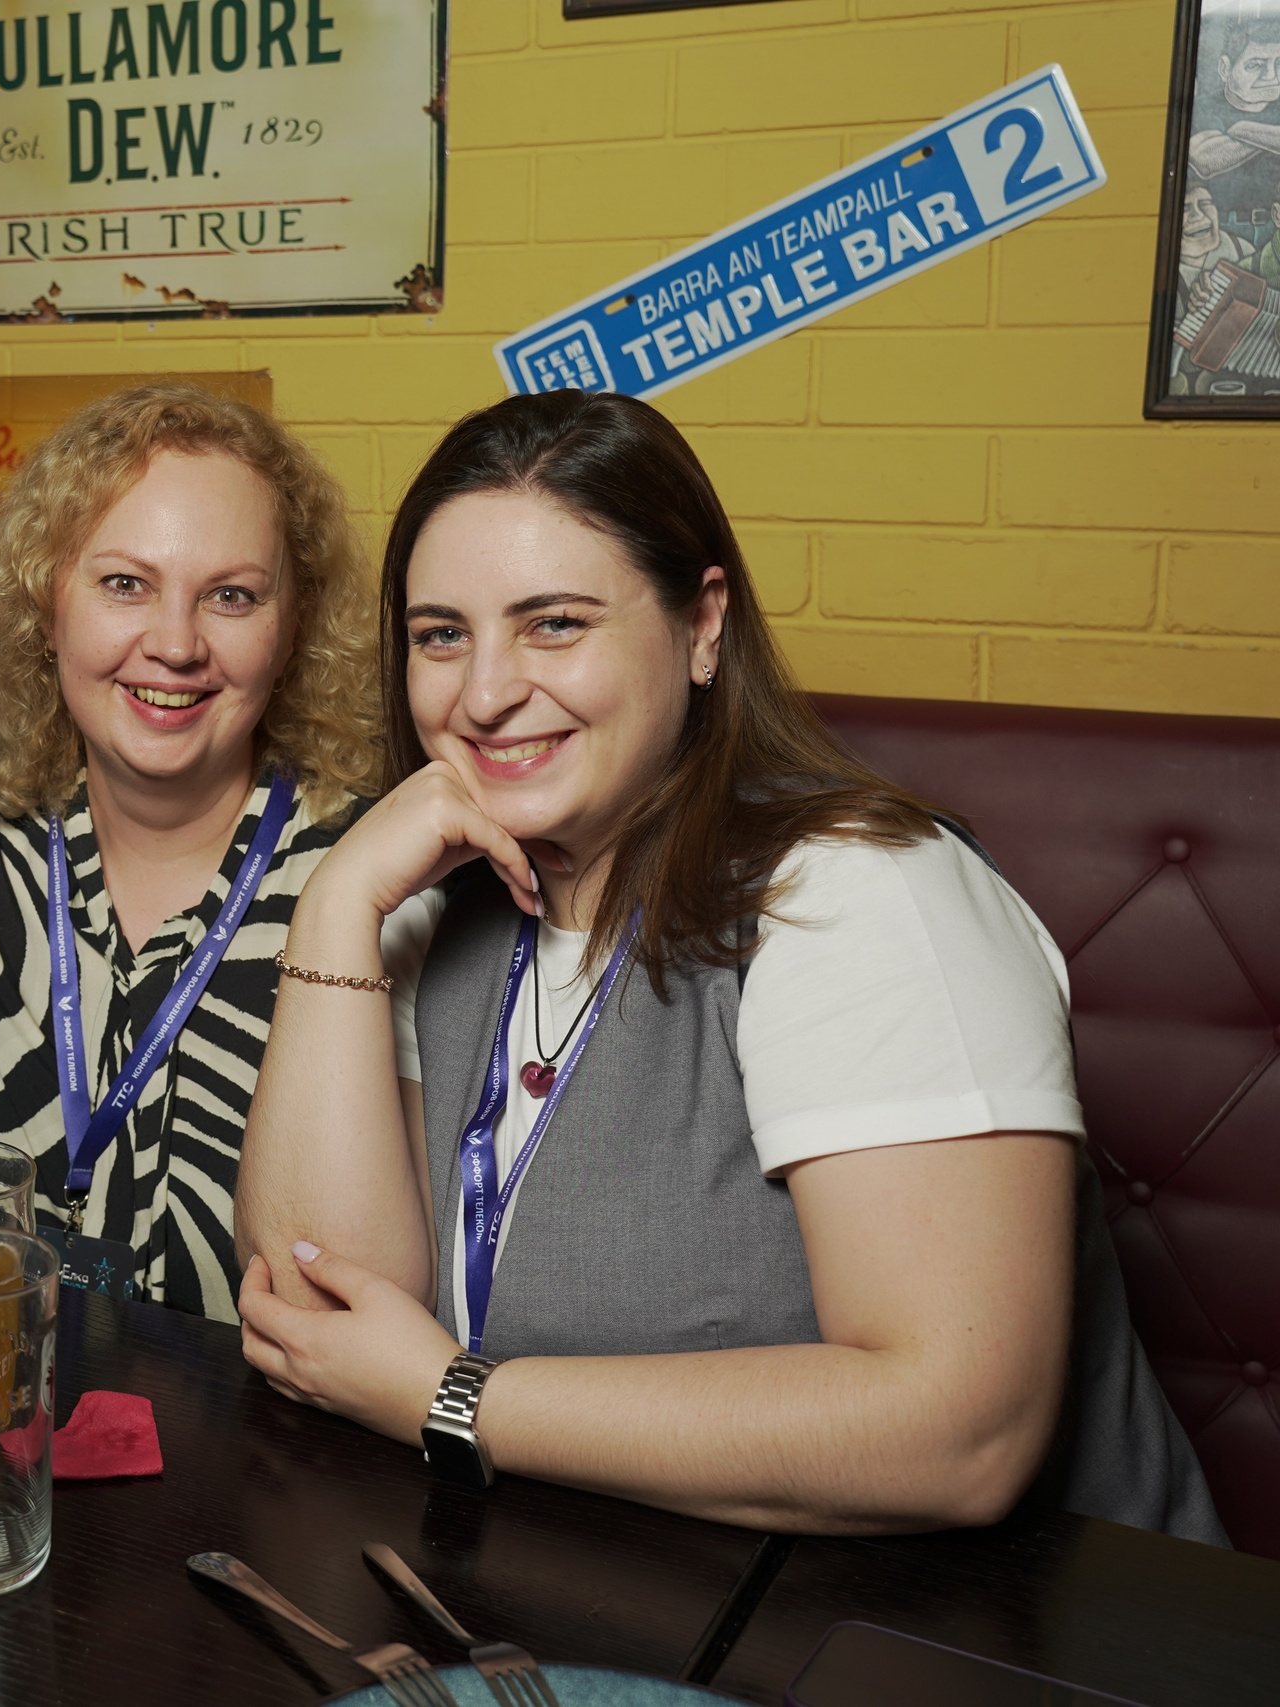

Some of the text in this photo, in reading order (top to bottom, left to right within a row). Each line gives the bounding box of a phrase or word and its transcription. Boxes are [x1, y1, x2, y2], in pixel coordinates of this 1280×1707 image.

[68, 98, 221, 186] D.E.W.
[243, 116, 324, 147] 1829
[983, 106, 1064, 206] 2
[160, 208, 305, 253] TRUE
[637, 170, 914, 326] BARRA AN TEAMPAILL
[621, 190, 970, 382] TEMPLE BAR
[533, 339, 585, 374] TEM
[541, 355, 593, 391] PLE
[225, 853, 263, 924] ЭФФОРТ ТЕЛЕКОМ
[55, 905, 67, 957] ОПЕРАТОРОВ
[59, 957, 68, 985] СВЯЗИ
[132, 1023, 170, 1080] КОНФЕРЕНЦИЯ
[166, 974, 199, 1025] ОПЕРАТОРОВ
[195, 950, 214, 979] СВЯЗИ
[63, 1015, 78, 1092] ЭФФОРТ ТЕЛЕКОМ
[490, 1043, 501, 1102] ОПЕРАТОРОВ
[471, 1151, 484, 1194] ЭФФОРТ
[501, 1134, 537, 1204] КОНФЕРЕНЦИЯ
[536, 1073, 570, 1135] ОПЕРАТОРОВ
